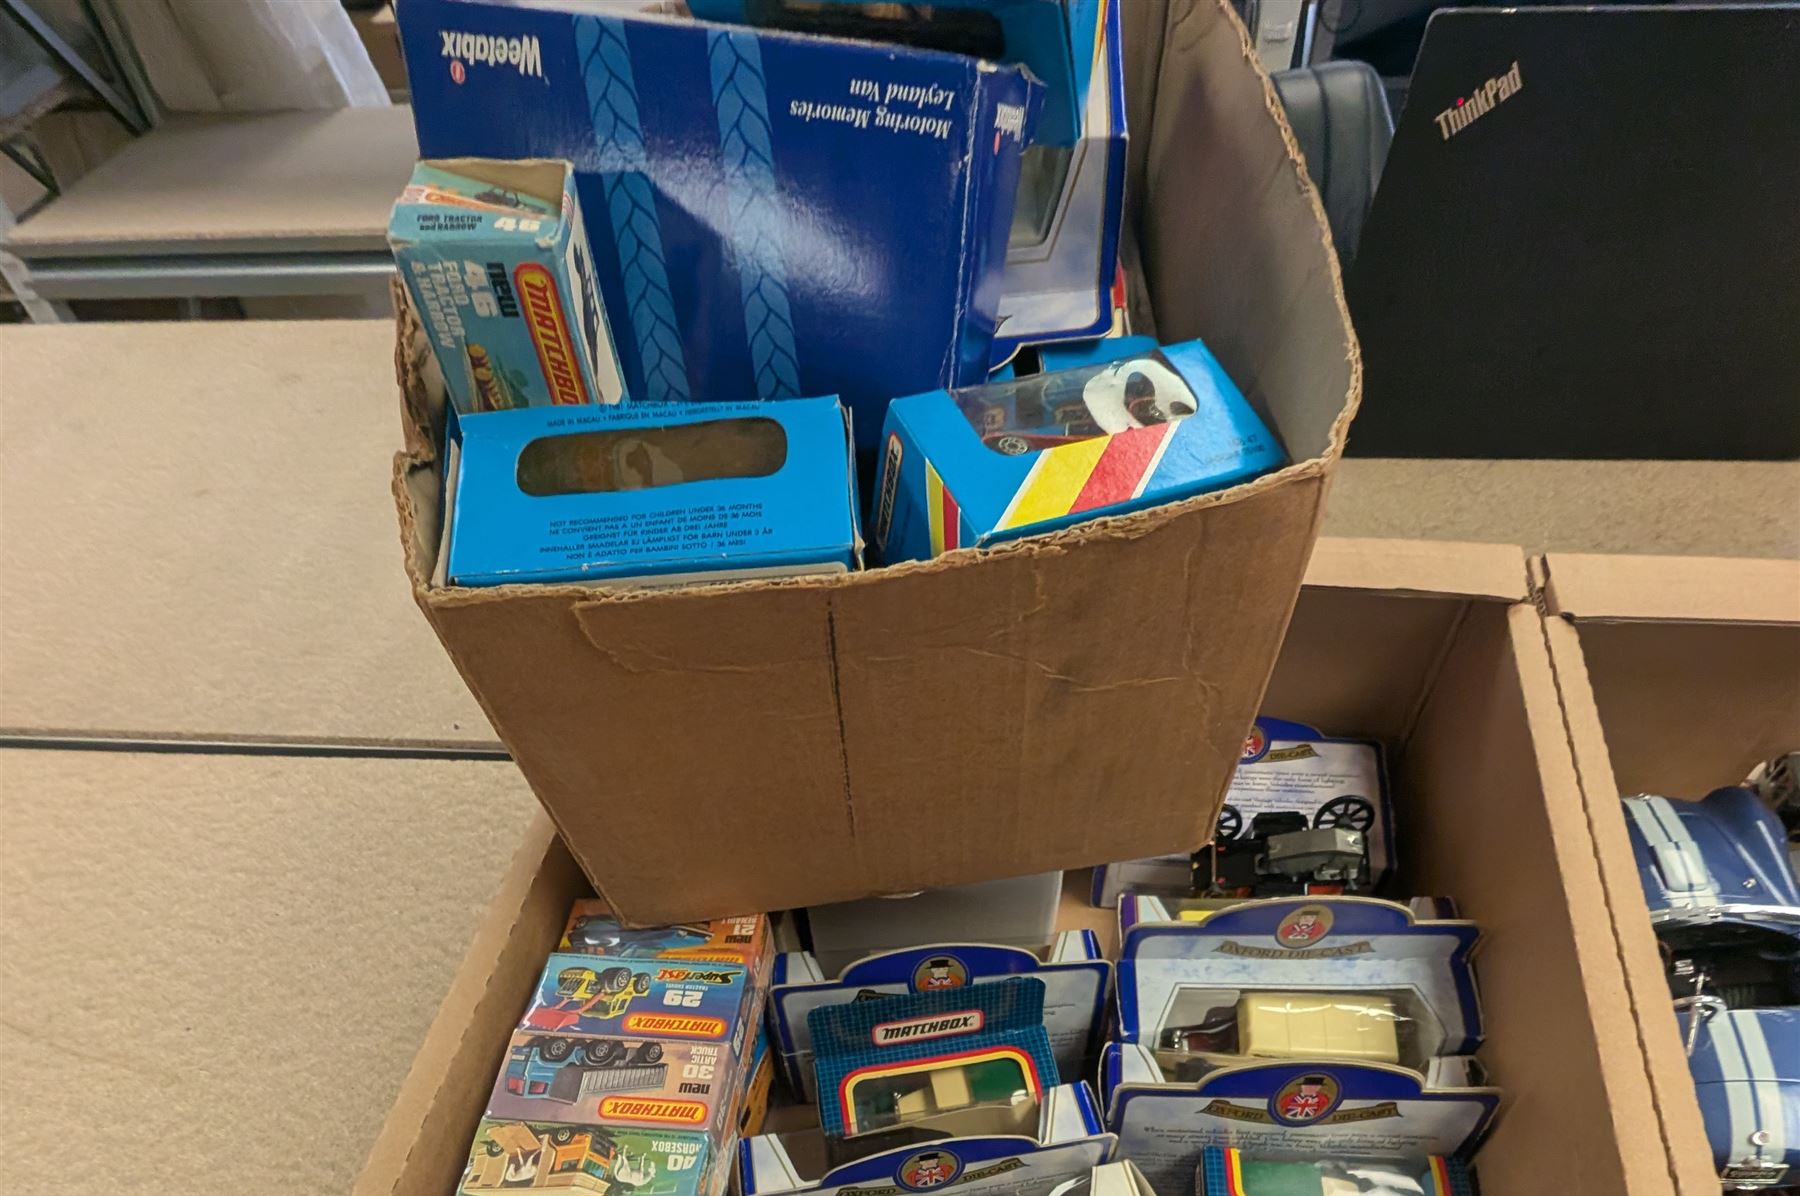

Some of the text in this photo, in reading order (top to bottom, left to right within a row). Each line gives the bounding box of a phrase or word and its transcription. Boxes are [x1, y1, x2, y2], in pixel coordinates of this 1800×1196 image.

[440, 30, 542, 77] Weetabix
[850, 78, 956, 111] Leyland Van
[1433, 60, 1523, 140] ThinkPad
[790, 100, 952, 139] Motoring Memories
[416, 214, 440, 223] FORD
[494, 217, 541, 232] 46
[463, 260, 499, 318] 46
[523, 279, 580, 405] MATCHBO
[688, 505, 714, 514] UNDER
[728, 503, 763, 511] MONTHS
[733, 924, 755, 935] 21
[1219, 942, 1284, 959] OXFORD
[656, 969, 743, 985] Superfast
[663, 990, 703, 1008] 29
[634, 1016, 720, 1034] MATCHBOX
[882, 1015, 972, 1041] MATCHBOX
[690, 1046, 718, 1056] TRUCK
[691, 1055, 718, 1065] ARTIC
[683, 1065, 715, 1079] 30
[678, 1082, 711, 1095] new
[609, 1101, 701, 1120] MATCHBOX
[667, 1154, 698, 1171] 40
